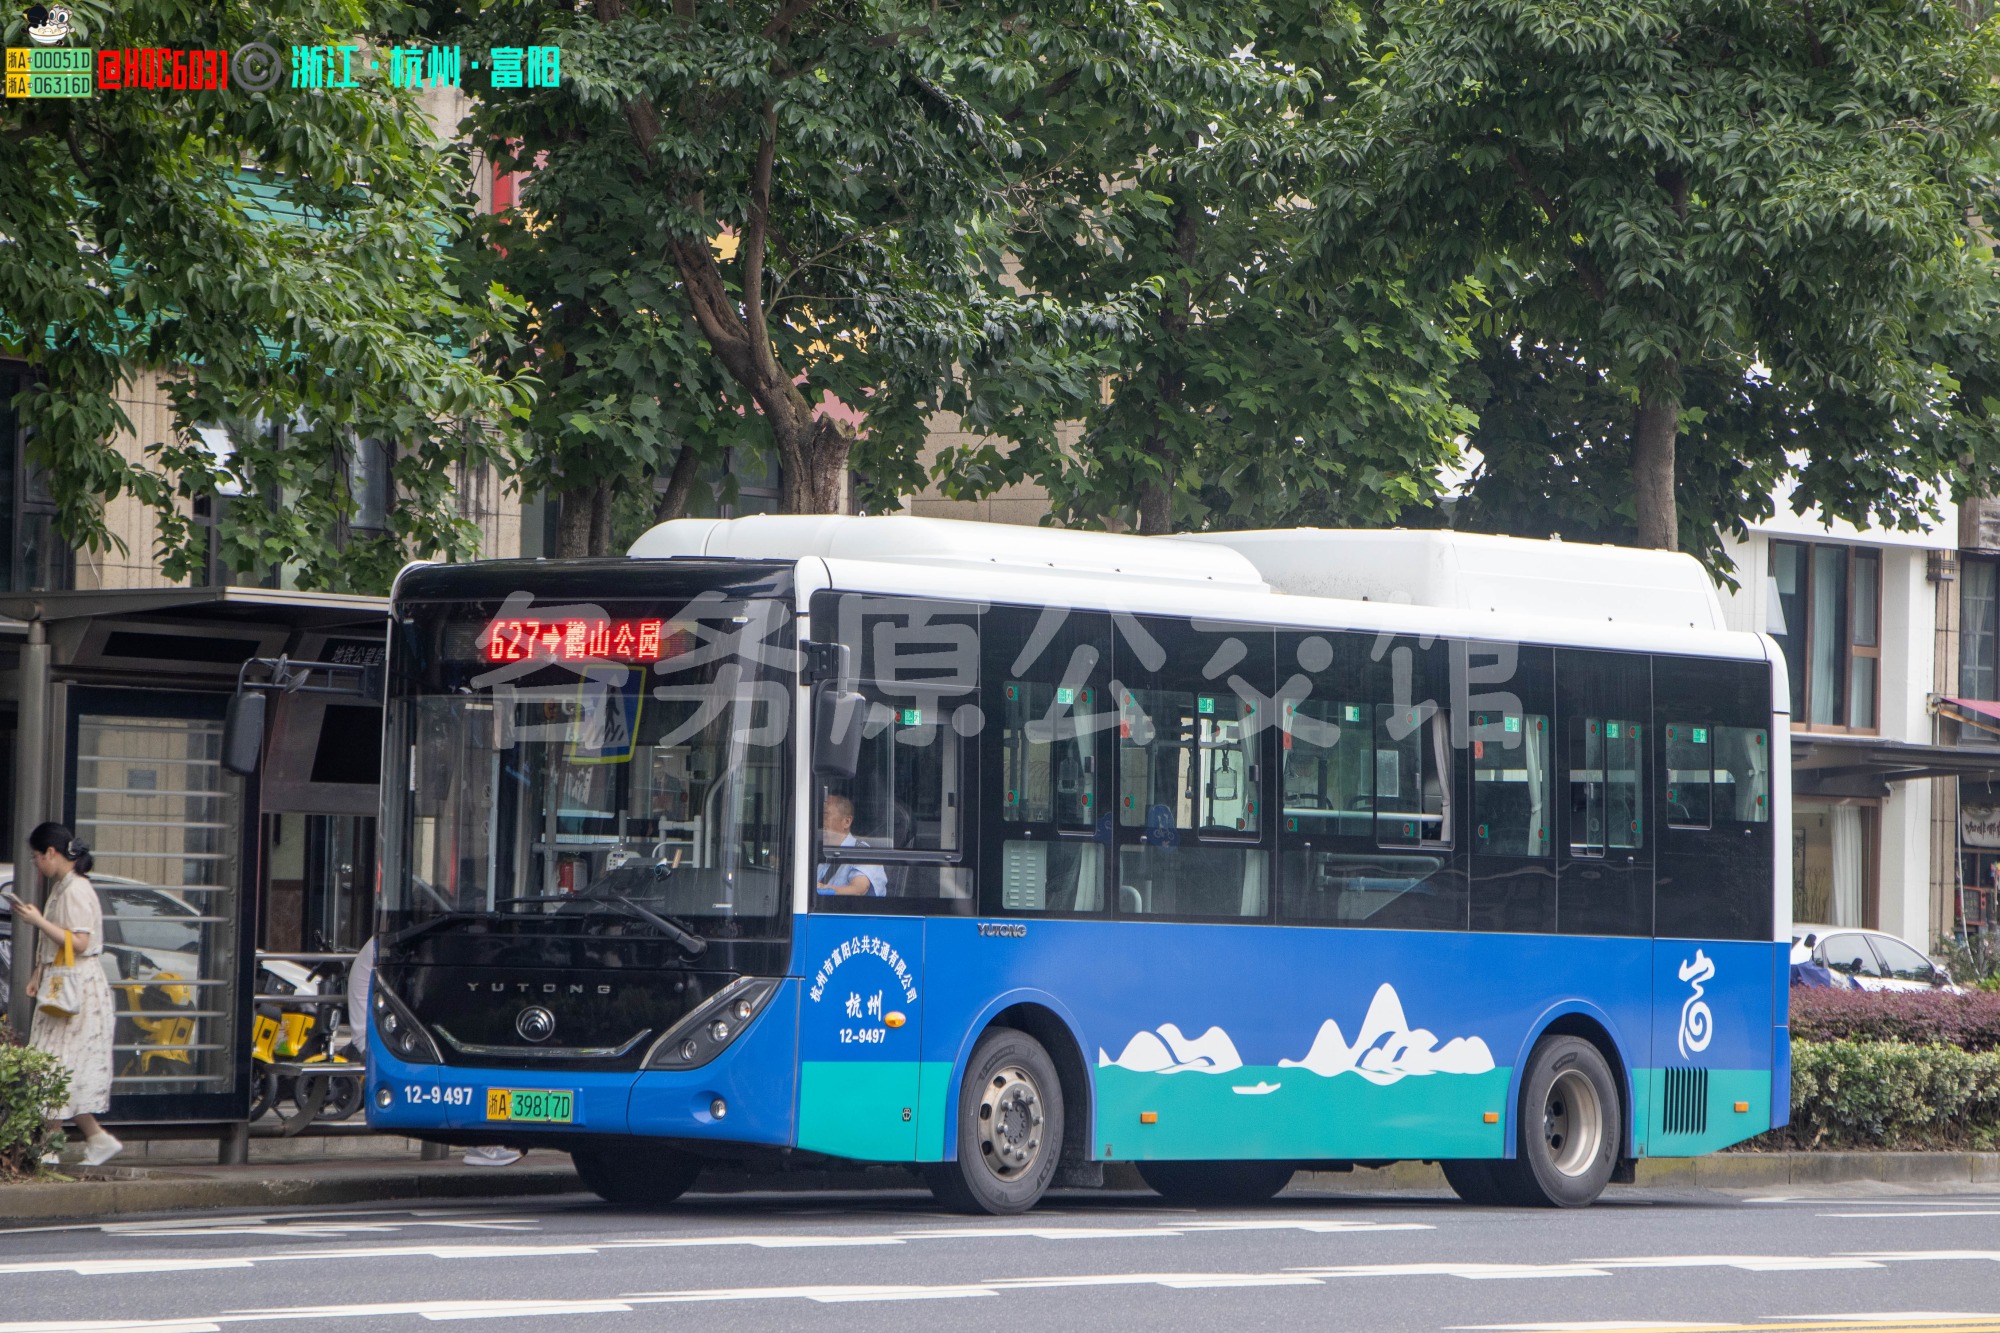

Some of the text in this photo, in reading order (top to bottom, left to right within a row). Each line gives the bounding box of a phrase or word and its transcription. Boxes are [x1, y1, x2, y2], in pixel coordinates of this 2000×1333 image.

[491, 621, 540, 659] 627
[977, 922, 1027, 938] YUTONG
[809, 934, 918, 1004] 杭州市富阳公共交通有限公司
[467, 982, 611, 994] YUTONG
[845, 989, 884, 1022] 杭州
[839, 1028, 886, 1044] 12-9497
[404, 1084, 473, 1106] 12-9497
